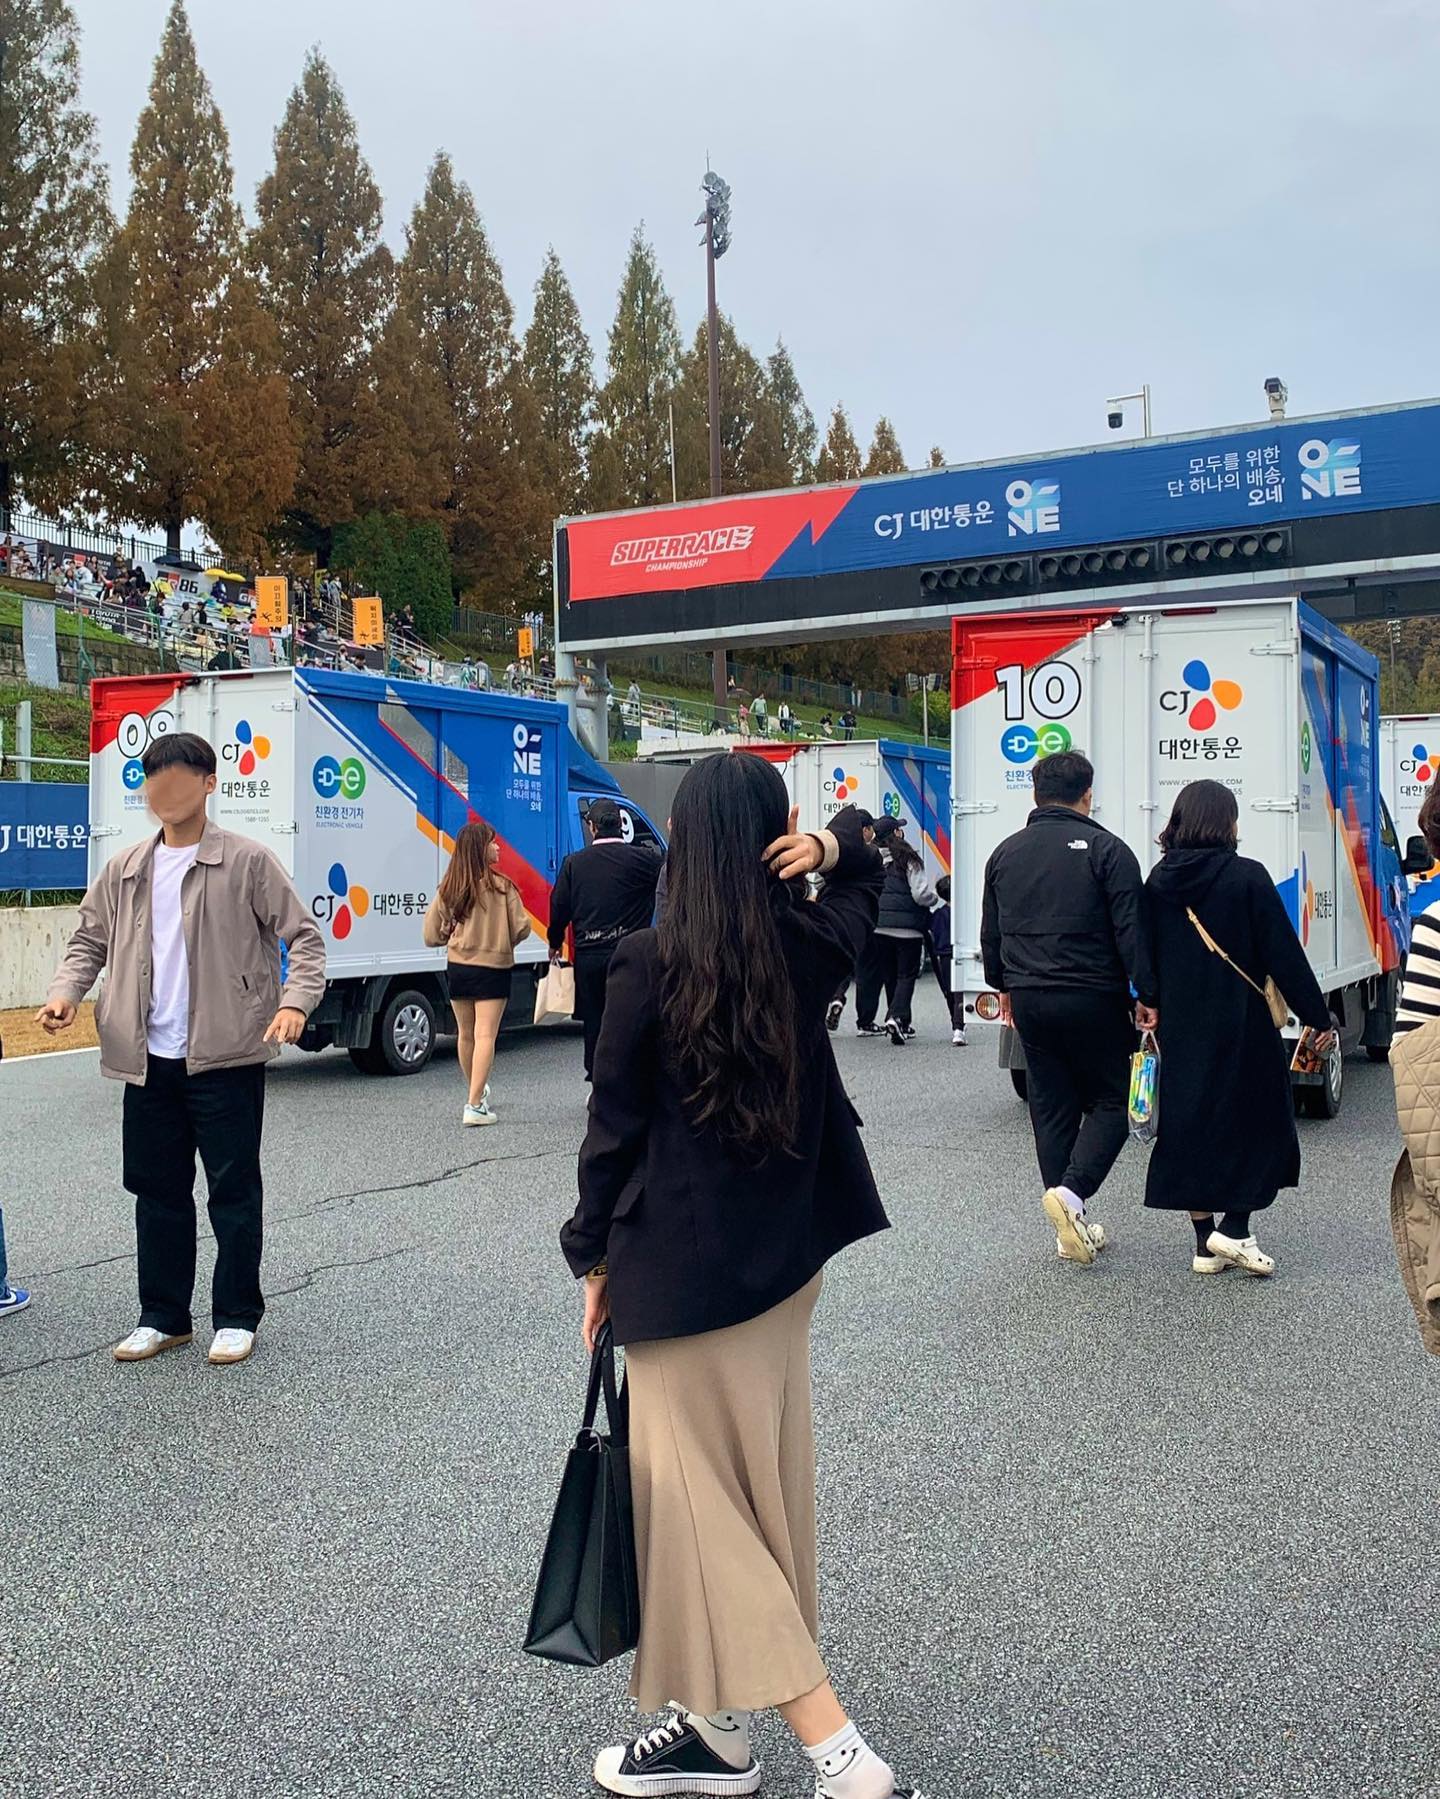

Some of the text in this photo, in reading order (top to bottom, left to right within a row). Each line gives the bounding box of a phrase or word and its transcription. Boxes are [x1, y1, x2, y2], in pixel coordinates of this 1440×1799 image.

[1189, 445, 1280, 475] 모두를 위한
[1168, 466, 1285, 498] 단 하나의 배송,
[1248, 485, 1283, 506] 오네
[874, 500, 994, 540] CJ 대한통운
[645, 558, 708, 573] CHAMPIONSHIP
[179, 579, 199, 594] 86
[994, 661, 1081, 720] 10
[1159, 690, 1191, 715] CJ
[222, 744, 241, 763] CJ
[1159, 736, 1242, 760] 대한통운
[1400, 760, 1417, 773] CJ
[221, 780, 271, 798] 대한통운
[823, 781, 837, 793] CJ
[315, 805, 364, 820] 친환경 전기차
[17, 824, 87, 849] 대한통운
[312, 892, 429, 923] CJ 대한통운
